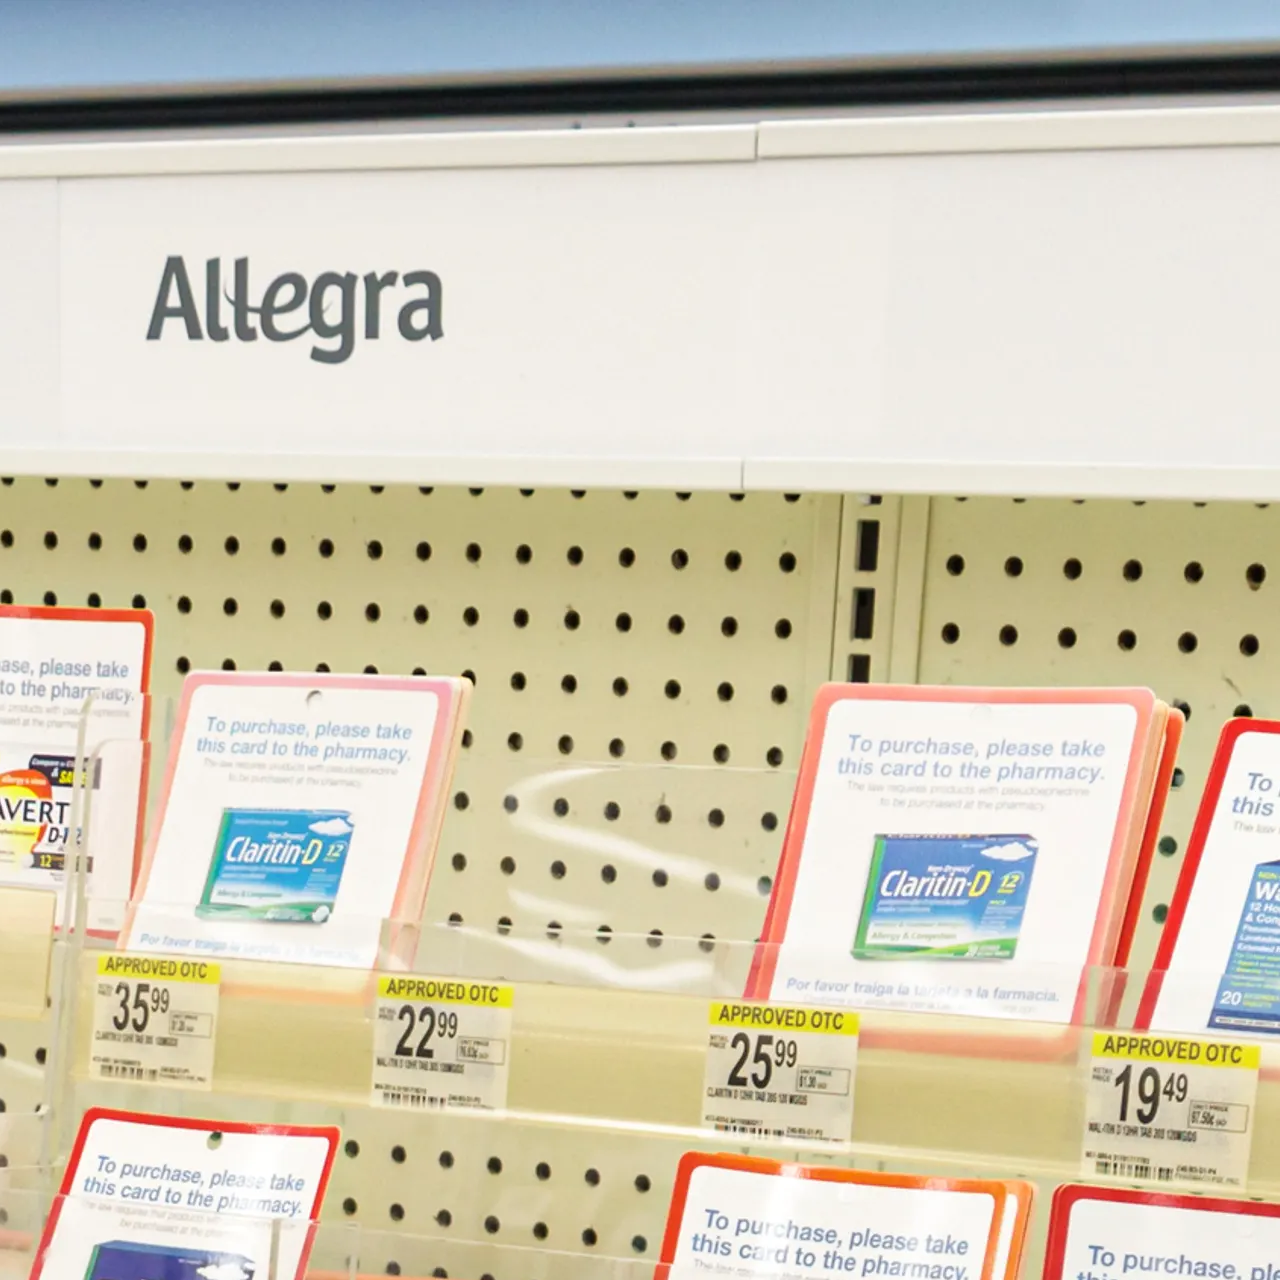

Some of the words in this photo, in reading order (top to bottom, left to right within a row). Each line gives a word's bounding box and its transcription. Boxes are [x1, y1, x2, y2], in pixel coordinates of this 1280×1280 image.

[147, 255, 445, 362] Allegra
[880, 868, 989, 898] Claritin-D
[105, 958, 175, 976] APPROVED
[179, 962, 207, 979] OTC
[1088, 1245, 1115, 1267] To
